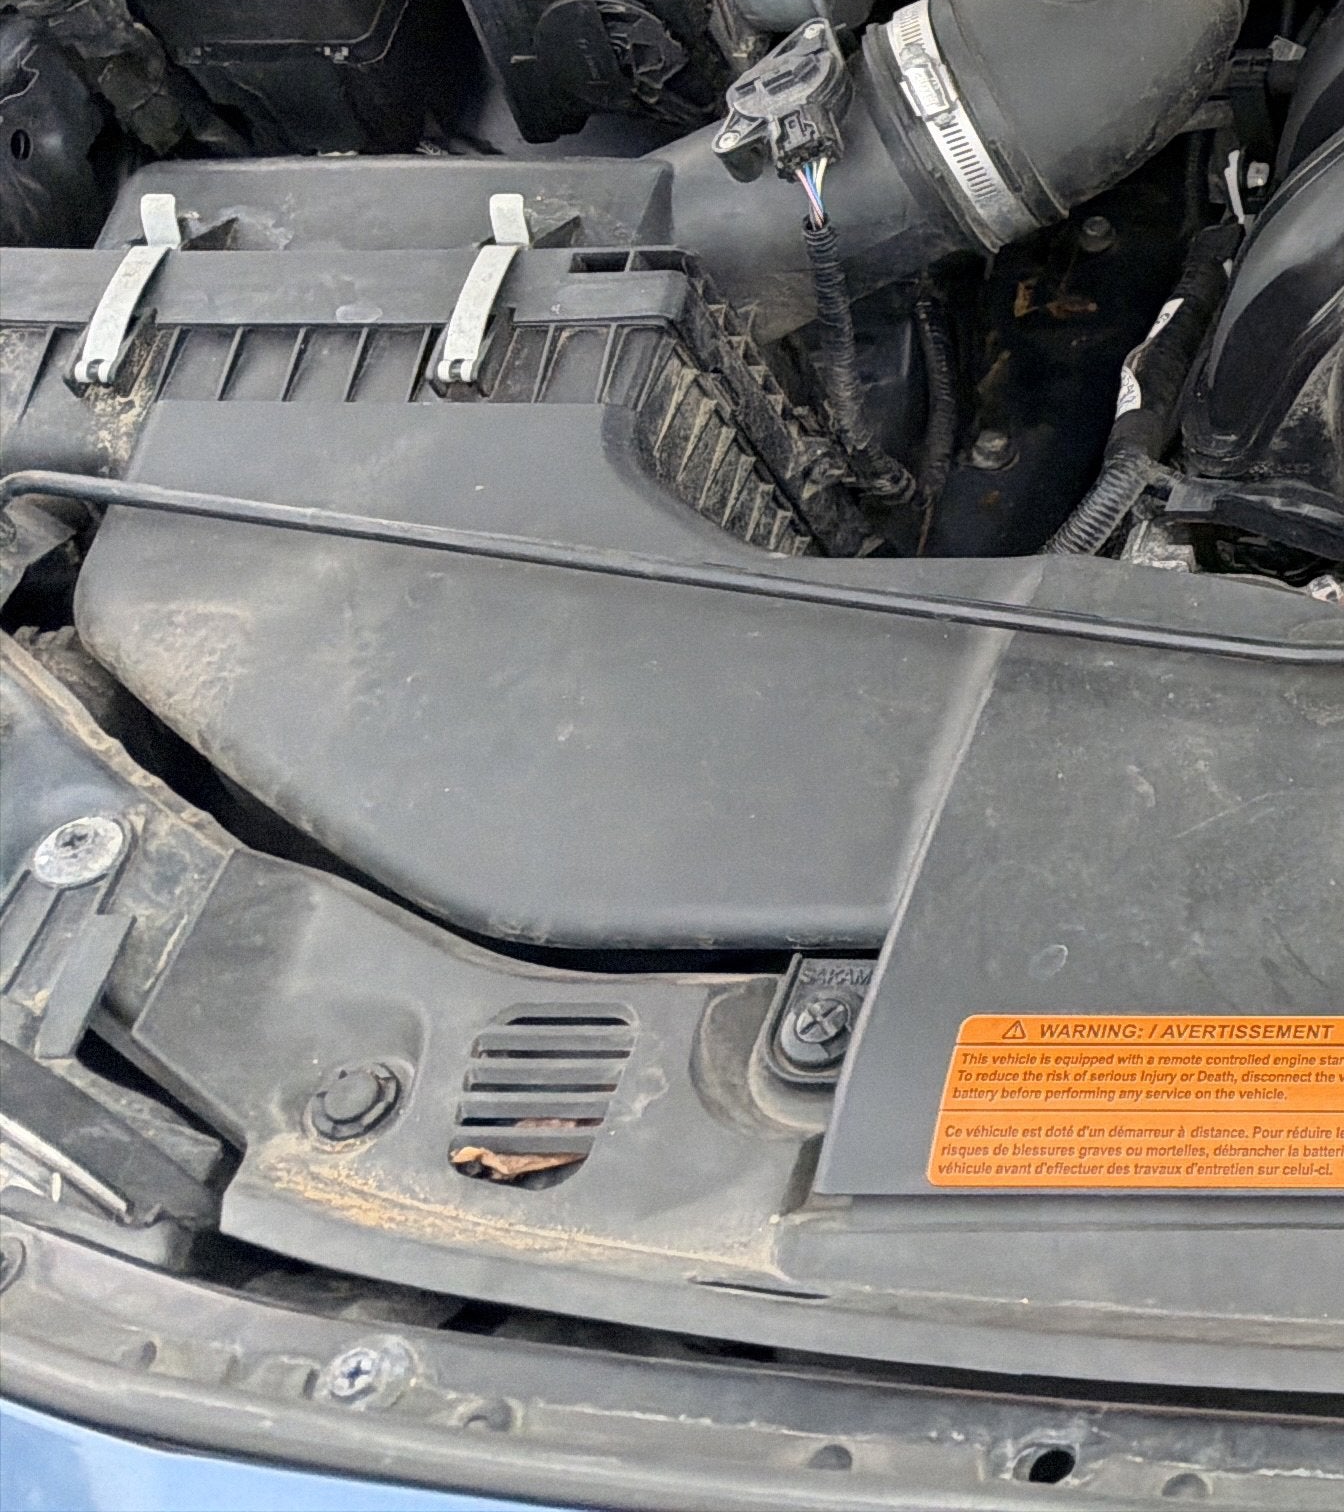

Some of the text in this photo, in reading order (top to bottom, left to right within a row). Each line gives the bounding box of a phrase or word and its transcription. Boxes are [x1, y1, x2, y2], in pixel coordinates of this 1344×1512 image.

[1040, 1023, 1144, 1039] WARNING:
[1160, 1024, 1335, 1040] AVERTISSEMENT
[962, 1053, 988, 1065] This
[992, 1053, 1037, 1065] vehicle
[1040, 1053, 1051, 1065] is
[1054, 1053, 1115, 1068] equipped
[1118, 1053, 1144, 1065] with
[1147, 1057, 1155, 1065] a
[1157, 1054, 1203, 1066] remote
[1206, 1054, 1271, 1066] controlled
[1273, 1054, 1317, 1068] engine
[958, 1071, 973, 1082] To
[976, 1071, 1020, 1082] reduce
[1022, 1071, 1044, 1082] the
[1046, 1071, 1071, 1082] risk
[1074, 1071, 1089, 1082] of
[1090, 1071, 1137, 1082] serious
[1140, 1071, 1177, 1084] injury
[1197, 1071, 1238, 1084] Death,
[1241, 1072, 1312, 1083] disconnect
[1315, 1072, 1336, 1083] the
[953, 1087, 1288, 1102] battery before performing any service on the vehicle.
[945, 1125, 962, 1138] Ce
[966, 1125, 1019, 1138] véhicule
[1022, 1126, 1042, 1138] est
[1045, 1125, 1074, 1138] doté
[1076, 1125, 1106, 1138] d'un
[1108, 1125, 1175, 1138] démarreur
[1177, 1125, 1186, 1138] à
[1190, 1126, 1249, 1139] distance.
[1252, 1126, 1285, 1139] Pour
[1286, 1126, 1333, 1139] réduire
[941, 1144, 989, 1158] risques
[992, 1144, 1009, 1156] de
[1012, 1144, 1076, 1156] blessures
[1078, 1147, 1122, 1158] graves
[1125, 1147, 1143, 1156] ou
[1146, 1144, 1210, 1158] mortelles,
[1213, 1144, 1285, 1157] débrancher
[1287, 1144, 1299, 1157] la
[938, 1162, 1333, 1176] véhicule avant d'effectuer des travaux d'entretien sur celui-ci.
